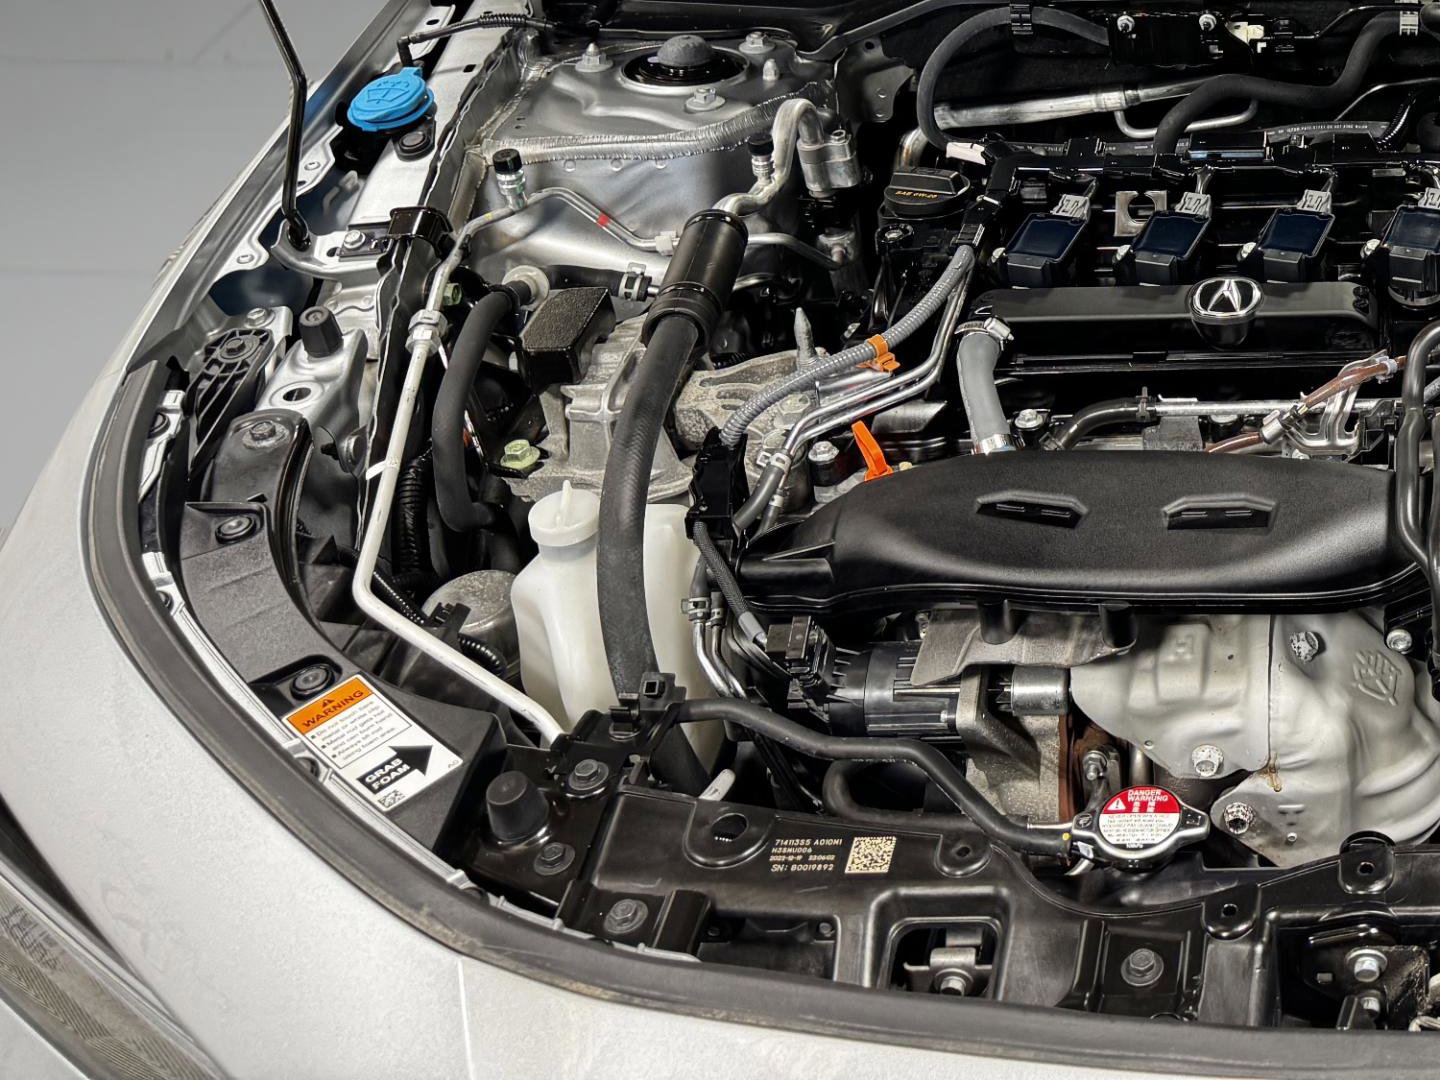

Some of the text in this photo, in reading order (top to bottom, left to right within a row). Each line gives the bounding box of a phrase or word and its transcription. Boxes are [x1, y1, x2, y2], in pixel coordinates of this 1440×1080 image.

[302, 689, 364, 728] WARNING
[366, 758, 403, 783] GRAB
[372, 764, 410, 790] FOAM
[771, 864, 788, 872] SN:
